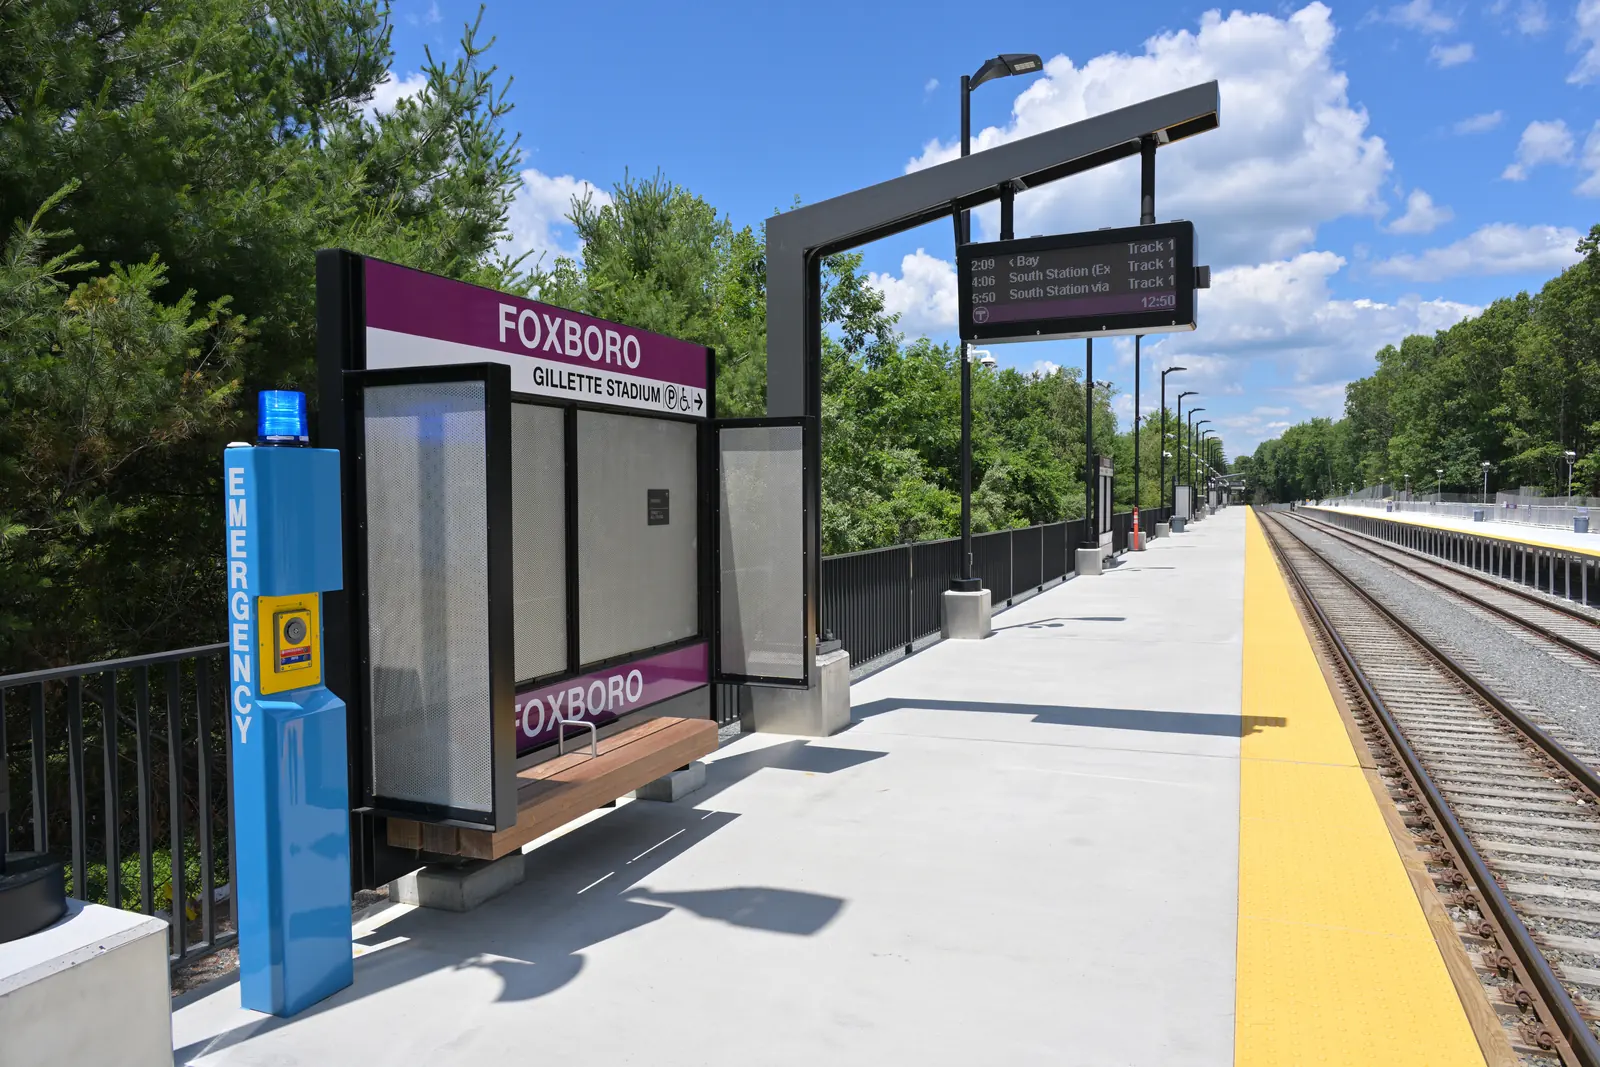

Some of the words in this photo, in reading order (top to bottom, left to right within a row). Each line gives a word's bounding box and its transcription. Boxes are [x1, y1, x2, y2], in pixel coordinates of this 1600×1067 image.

[1017, 255, 1040, 267] Bay
[1128, 240, 1163, 254] Track
[1168, 239, 1174, 250] 1
[971, 275, 996, 287] 4:06
[1009, 270, 1043, 283] South
[1046, 266, 1088, 280] Station
[1092, 264, 1111, 277] (Ex
[1128, 258, 1163, 272] Track
[1168, 257, 1174, 268] 1
[1009, 286, 1043, 300] South
[1046, 284, 1089, 297] Station
[1091, 281, 1109, 293] via
[1128, 276, 1164, 289] Track
[1168, 275, 1174, 286] 1
[1141, 295, 1176, 308] 12:50
[499, 302, 641, 369] FOXBORO
[533, 366, 602, 395] GILLETTE
[606, 378, 661, 404] STADIUM
[228, 467, 252, 744] EMERGENCY
